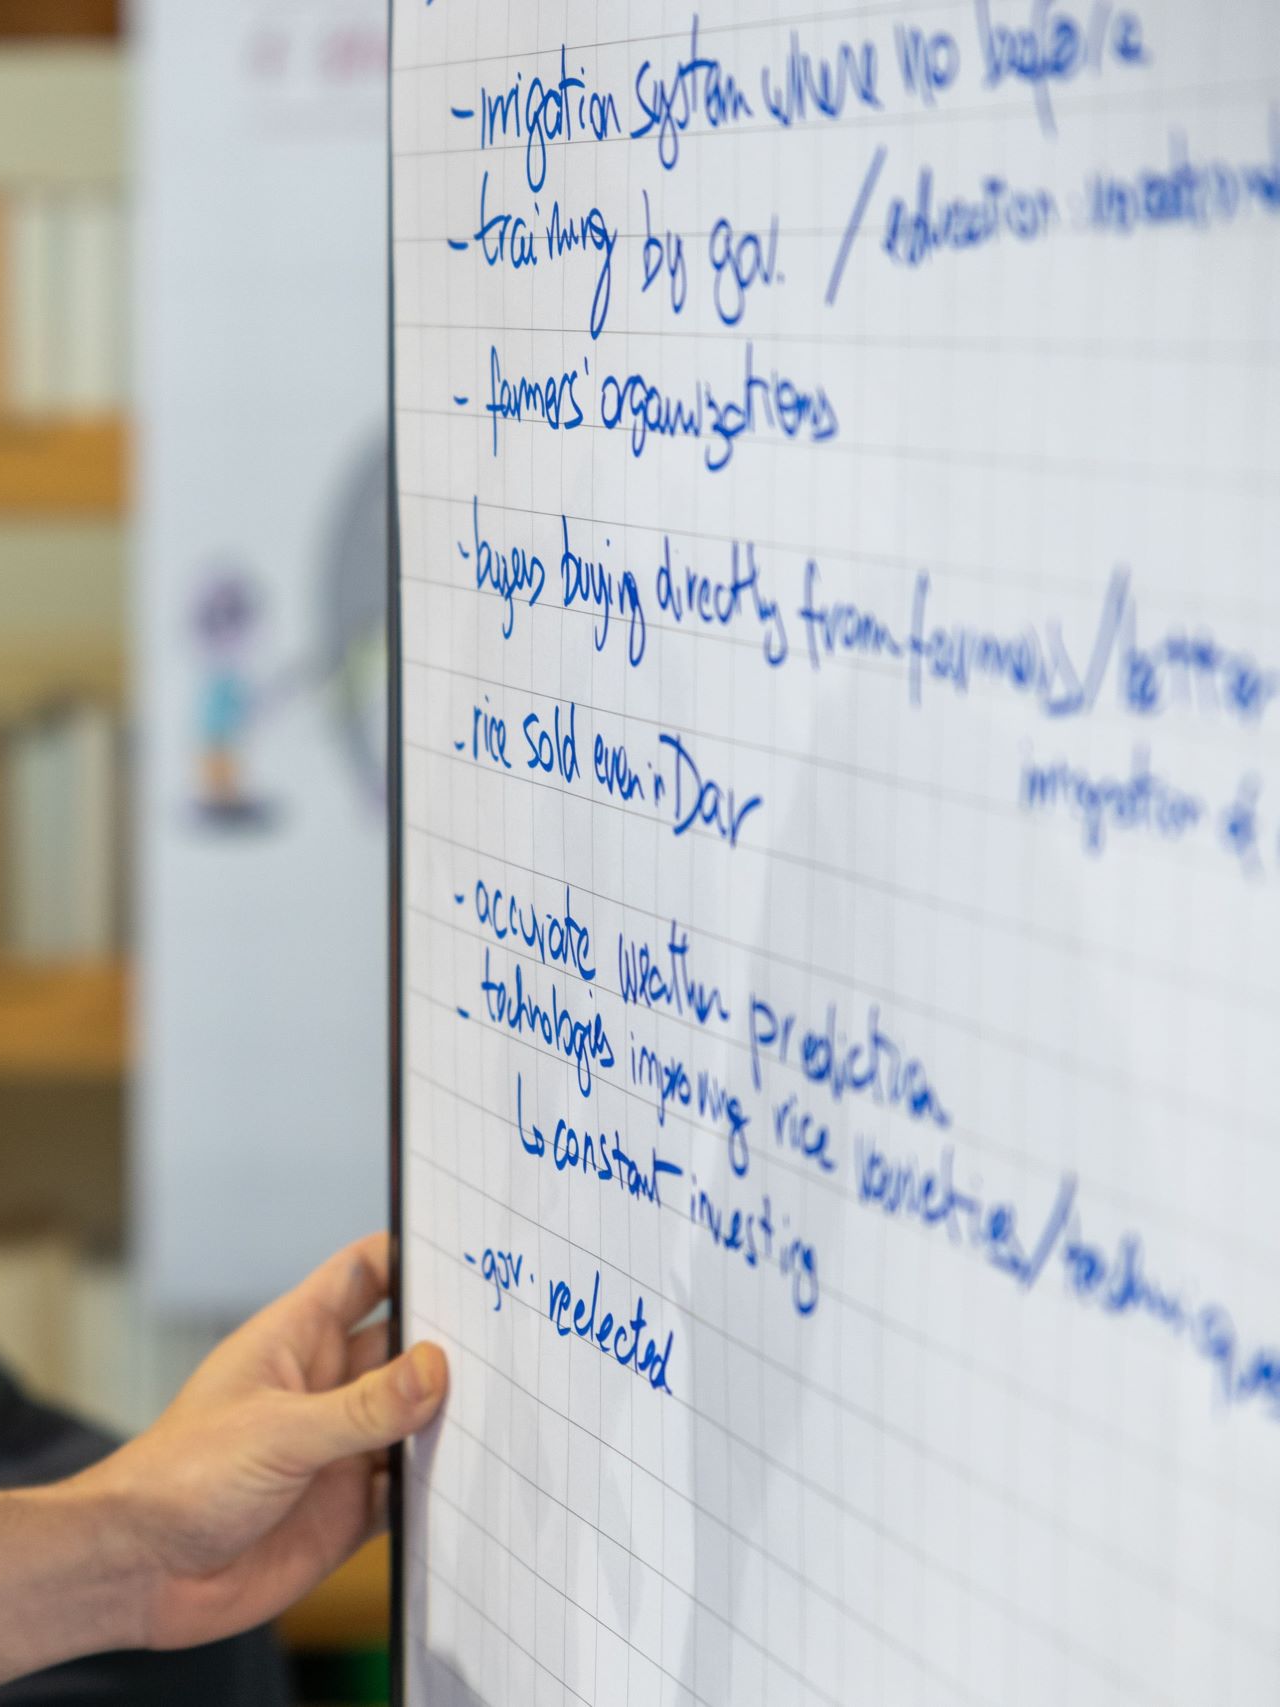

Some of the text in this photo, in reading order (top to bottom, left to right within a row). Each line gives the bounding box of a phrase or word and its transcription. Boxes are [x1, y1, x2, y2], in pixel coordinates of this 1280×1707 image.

[641, 189, 687, 314] by
[601, 339, 839, 472] organizations
[561, 514, 646, 666] buying
[656, 534, 790, 664] directly
[659, 732, 764, 849] Dar
[481, 946, 615, 1098] technologies
[630, 1031, 749, 1177] improving
[771, 1094, 838, 1174] rice
[554, 1119, 820, 1318] constant investing
[549, 1271, 673, 1395] reelected
